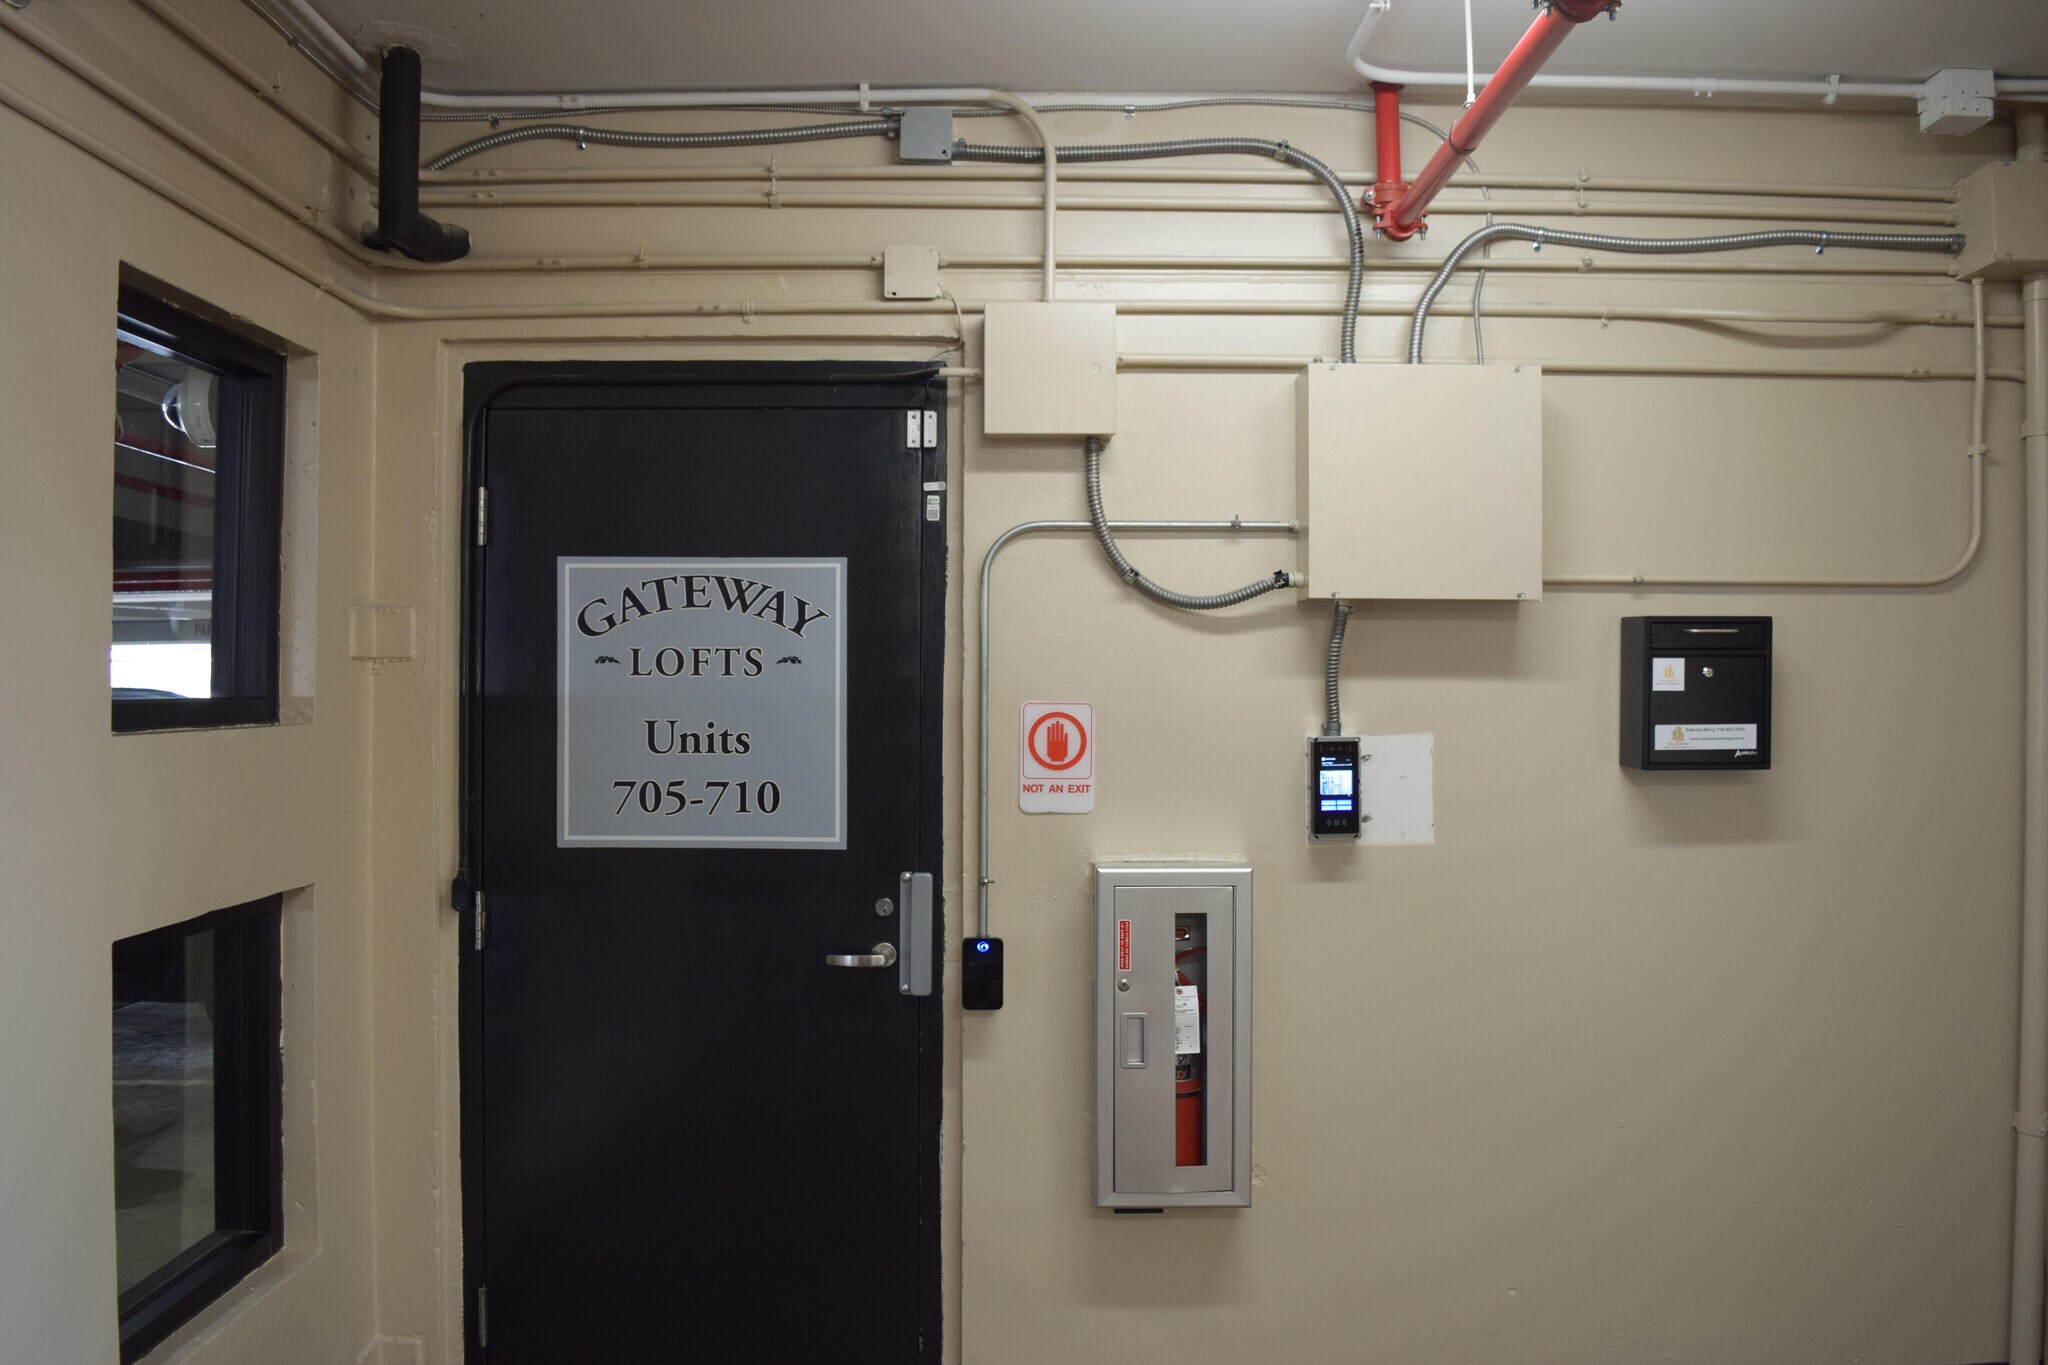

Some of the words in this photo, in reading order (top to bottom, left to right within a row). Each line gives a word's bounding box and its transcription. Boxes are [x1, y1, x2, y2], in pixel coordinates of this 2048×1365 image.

[575, 573, 831, 639] GATEWAY
[629, 647, 763, 678] LOFTS
[643, 718, 752, 756] Units
[611, 779, 782, 817] 705-710
[1023, 784, 1045, 793] NOT
[1049, 784, 1064, 793] AN
[1068, 784, 1091, 793] EXIT
